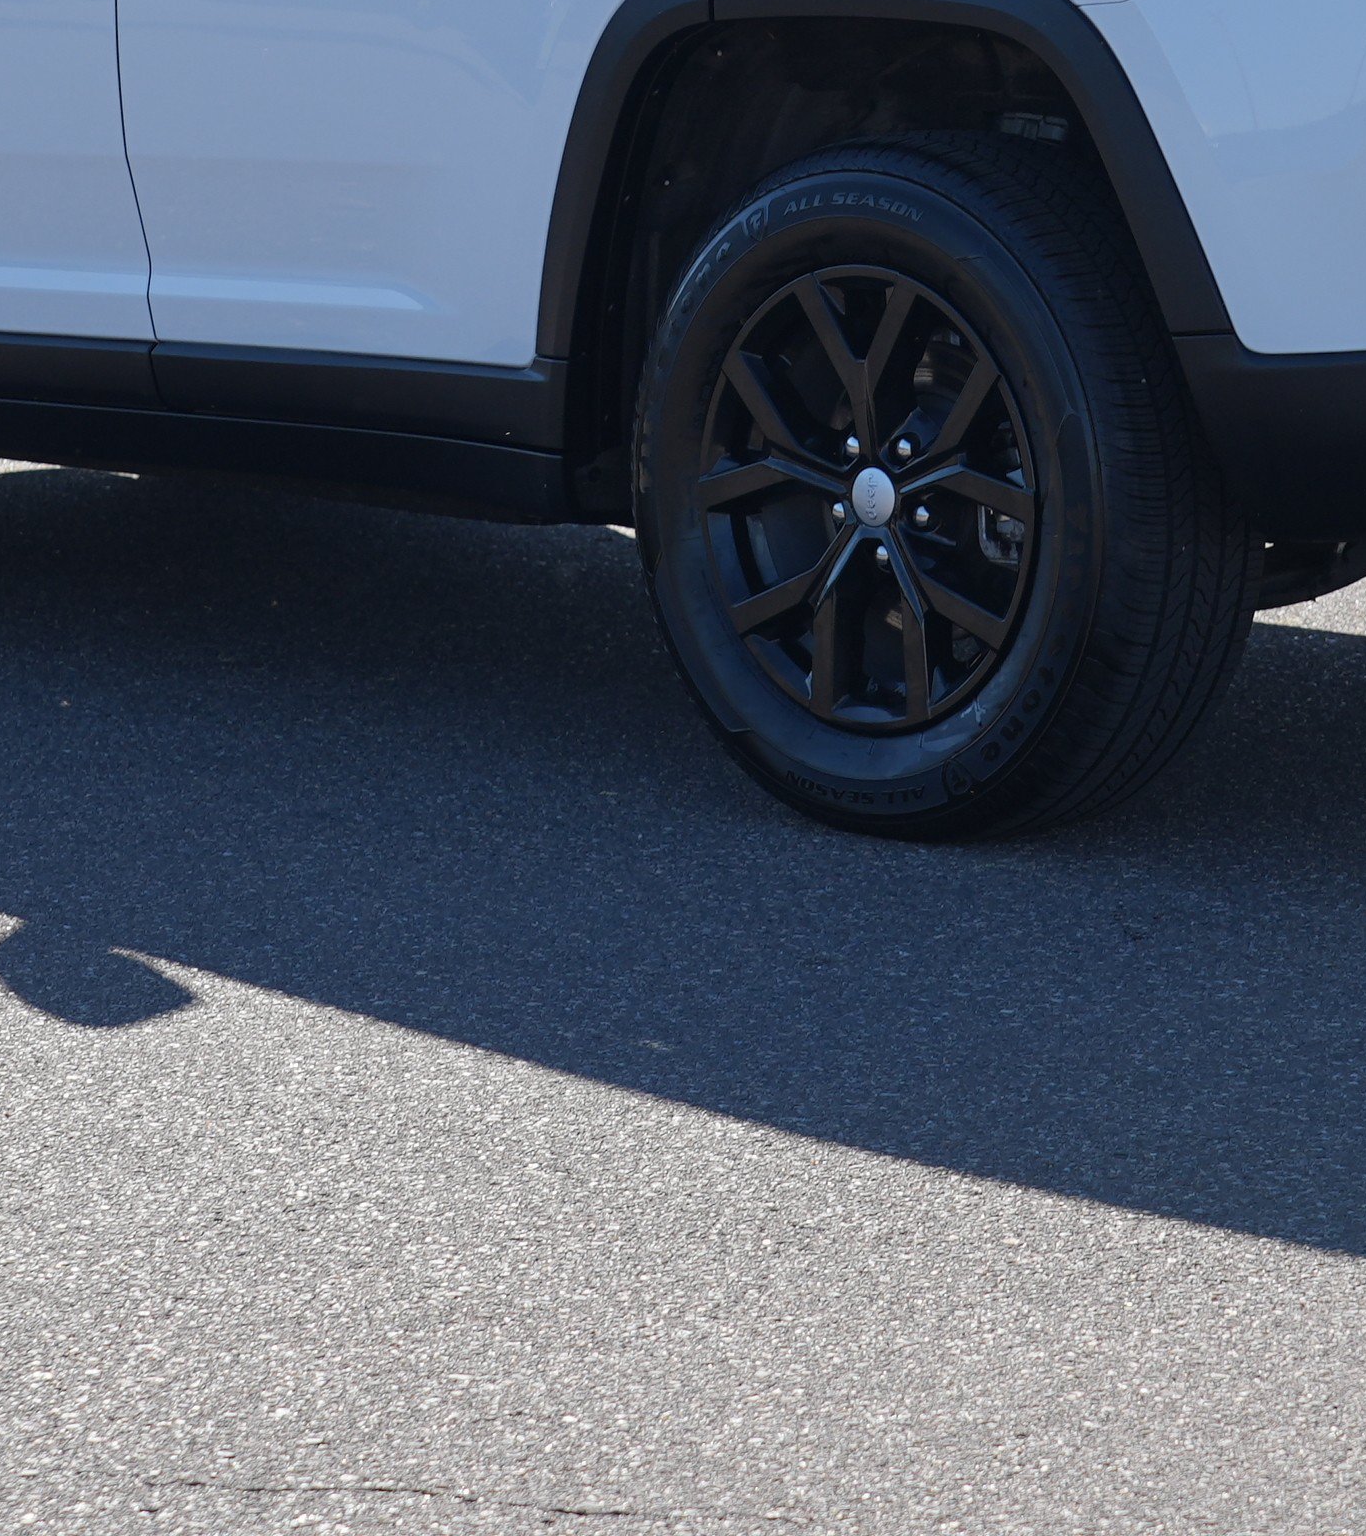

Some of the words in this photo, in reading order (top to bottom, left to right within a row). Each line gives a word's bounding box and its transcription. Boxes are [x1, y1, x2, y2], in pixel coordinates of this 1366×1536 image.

[784, 193, 825, 215] ALL
[831, 191, 925, 223] SEASON
[784, 769, 876, 806] SEASON
[887, 783, 927, 805] ALL
